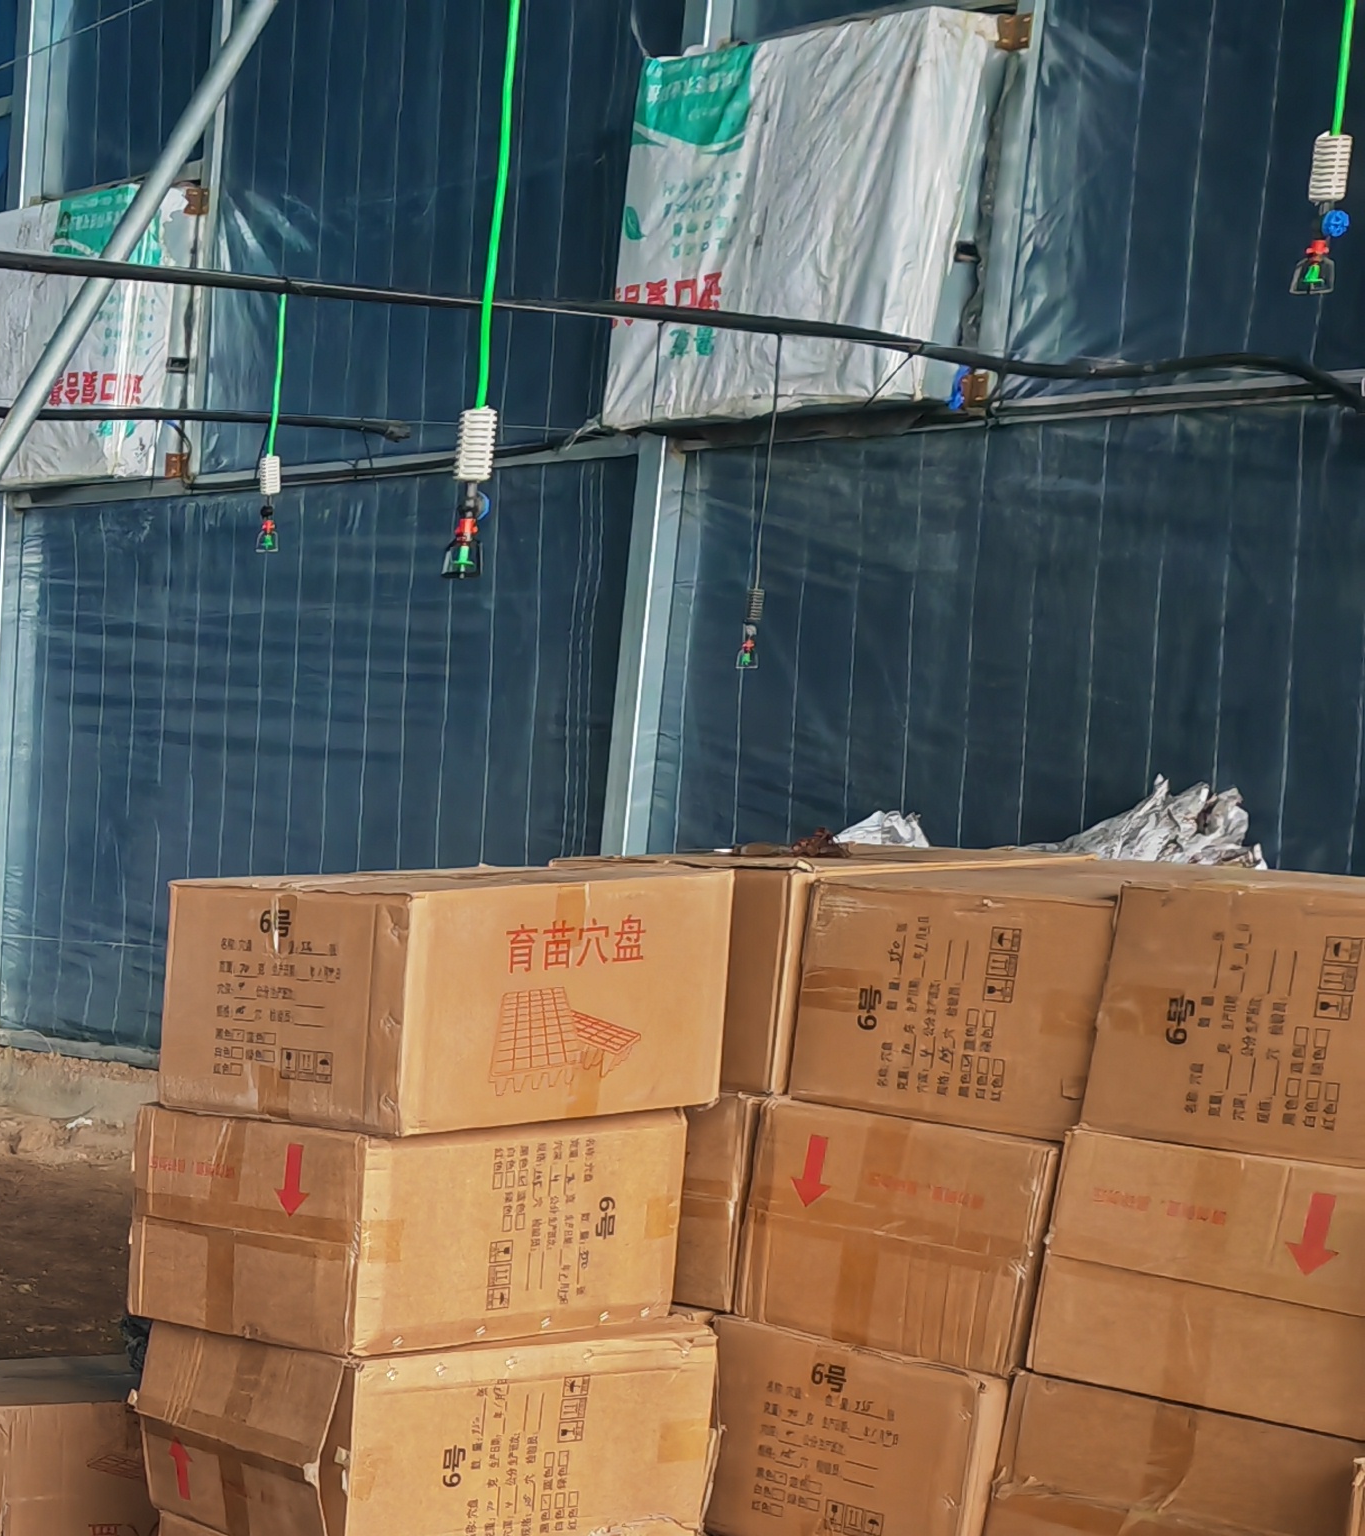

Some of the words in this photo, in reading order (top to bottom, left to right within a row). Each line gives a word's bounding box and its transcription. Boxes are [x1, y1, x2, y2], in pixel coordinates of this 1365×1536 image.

[505, 914, 646, 974] 育苗穴盘
[857, 984, 882, 1031] 6号
[1166, 992, 1195, 1045] 6号
[595, 1196, 616, 1240] 6号
[810, 1362, 847, 1393] 6号
[443, 1444, 466, 1487] 6号
